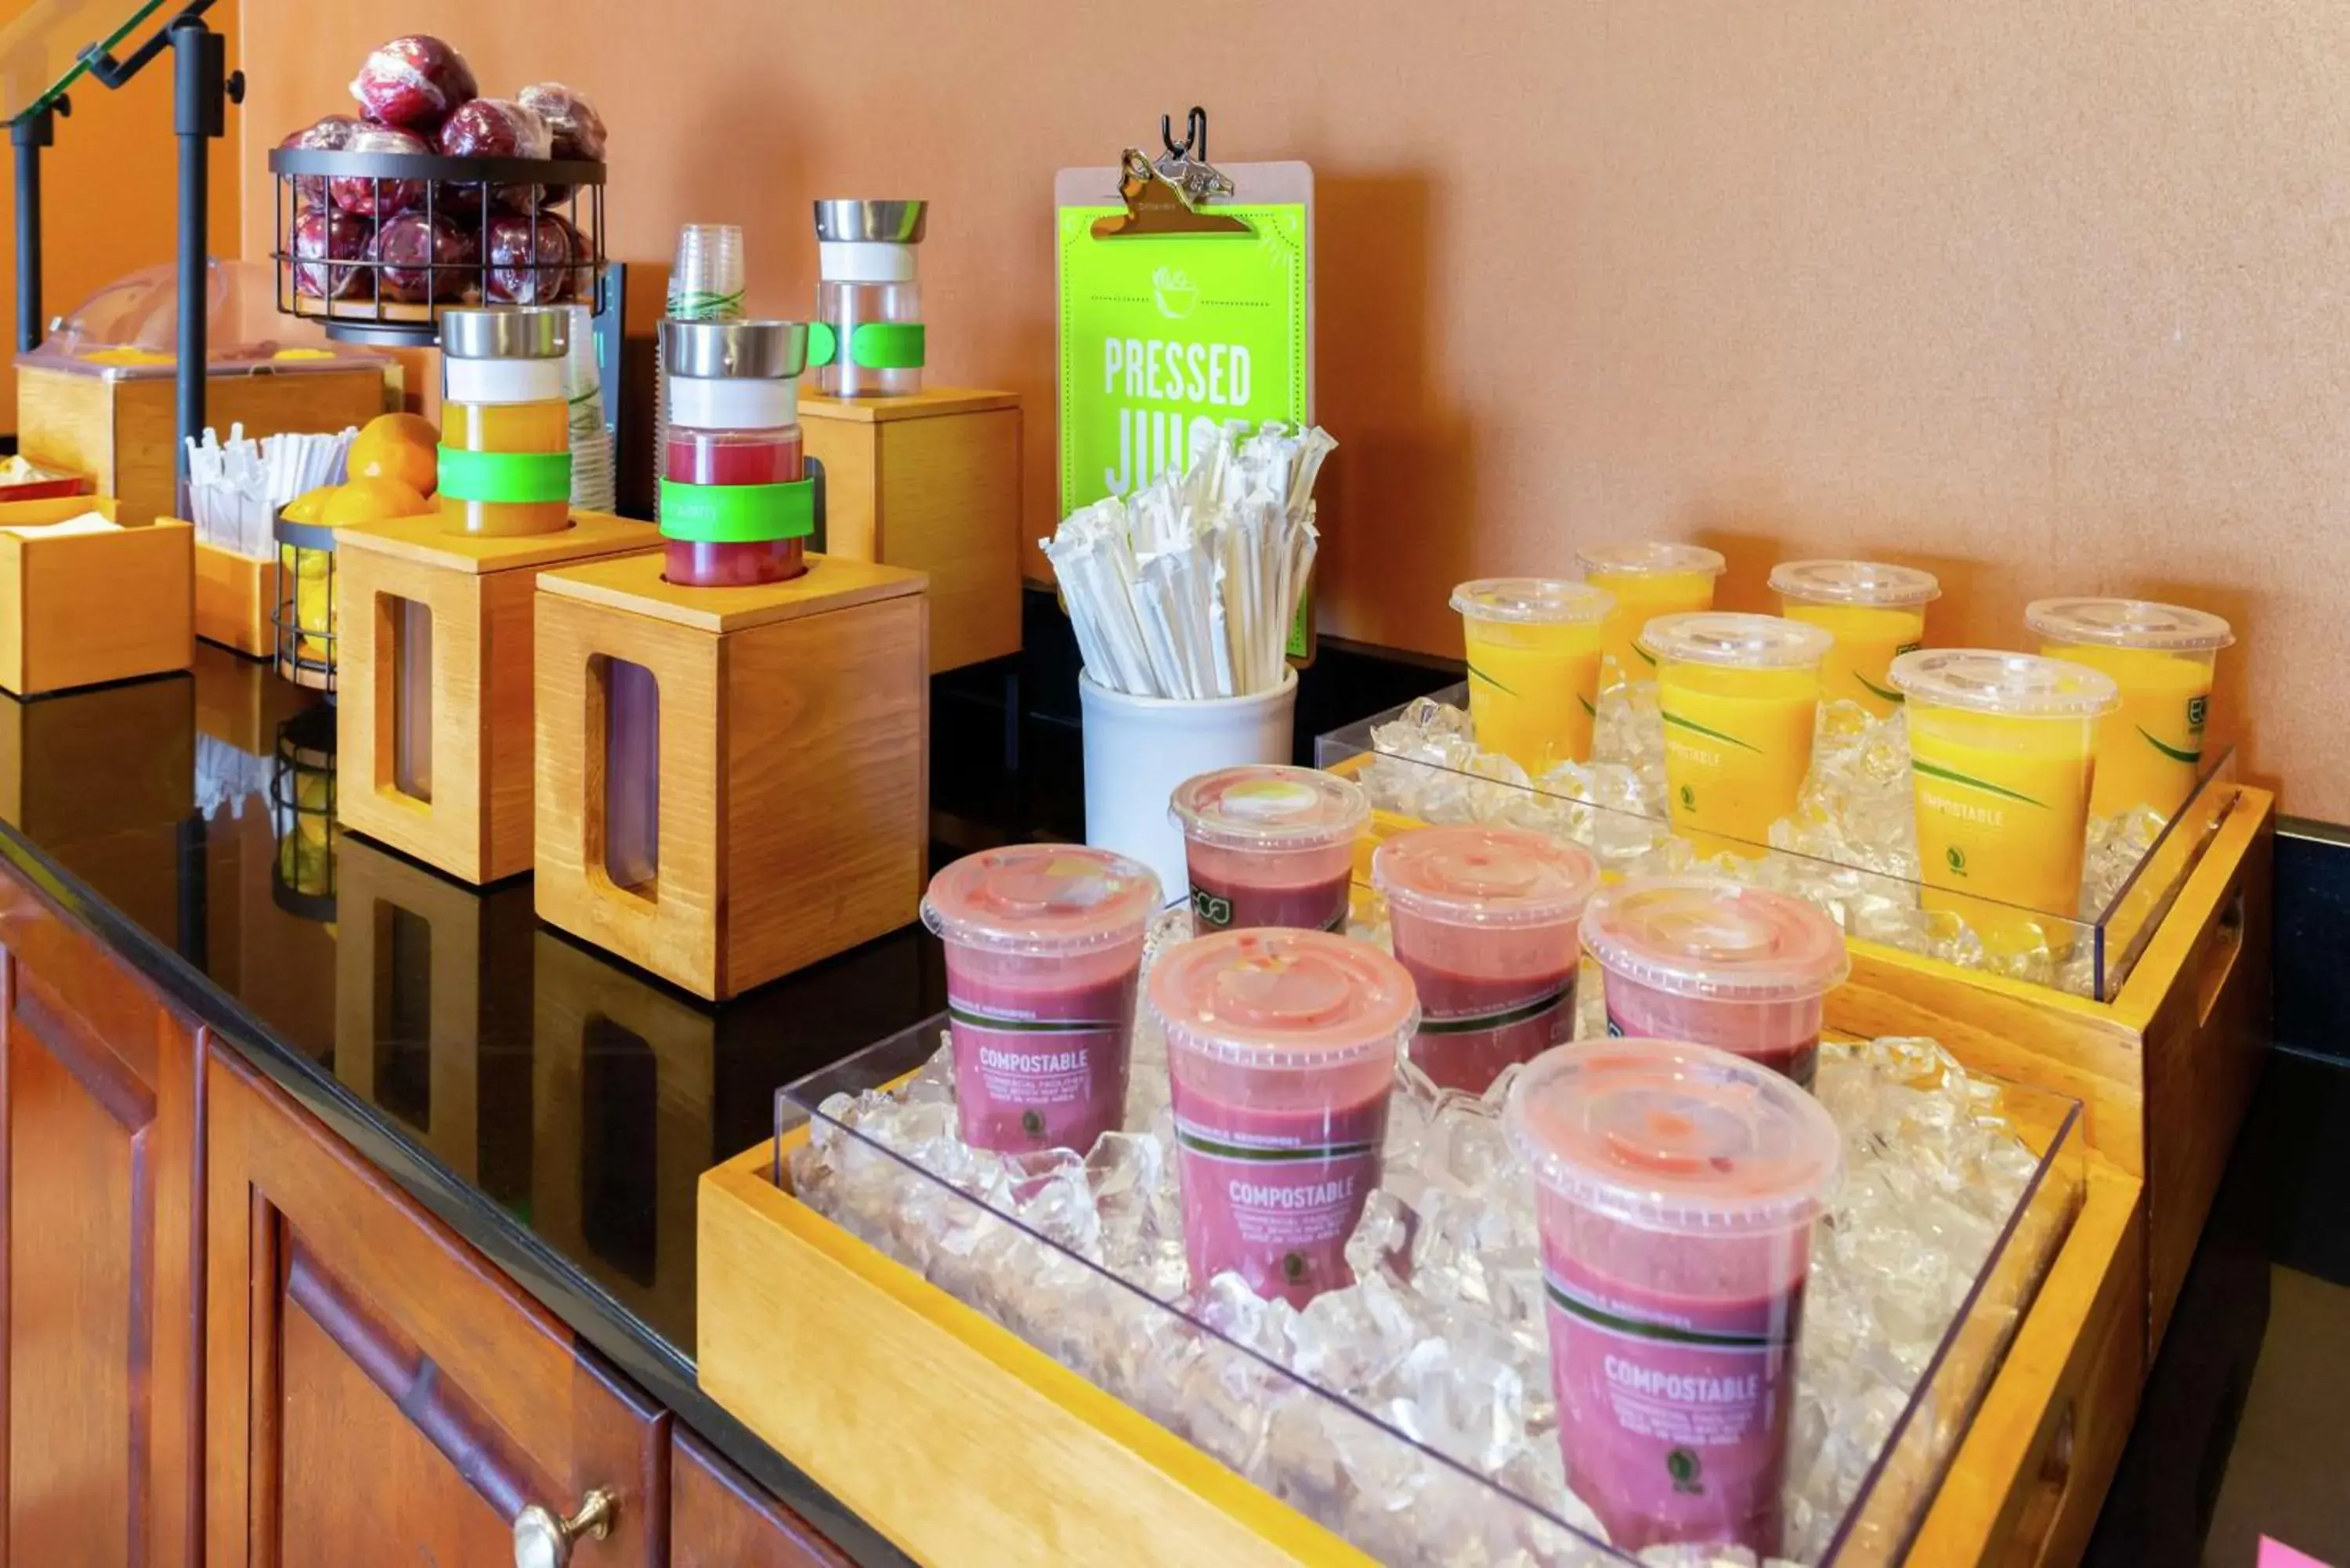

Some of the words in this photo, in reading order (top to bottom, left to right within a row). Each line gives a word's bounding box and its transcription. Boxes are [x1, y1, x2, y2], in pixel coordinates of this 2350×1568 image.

[1105, 338, 1251, 406] PRESSED
[980, 1045, 1090, 1074] COMPOSTABLE
[1228, 1176, 1354, 1209] COMPOSTABLE
[1604, 1354, 1759, 1403] COMPOSTABLE
